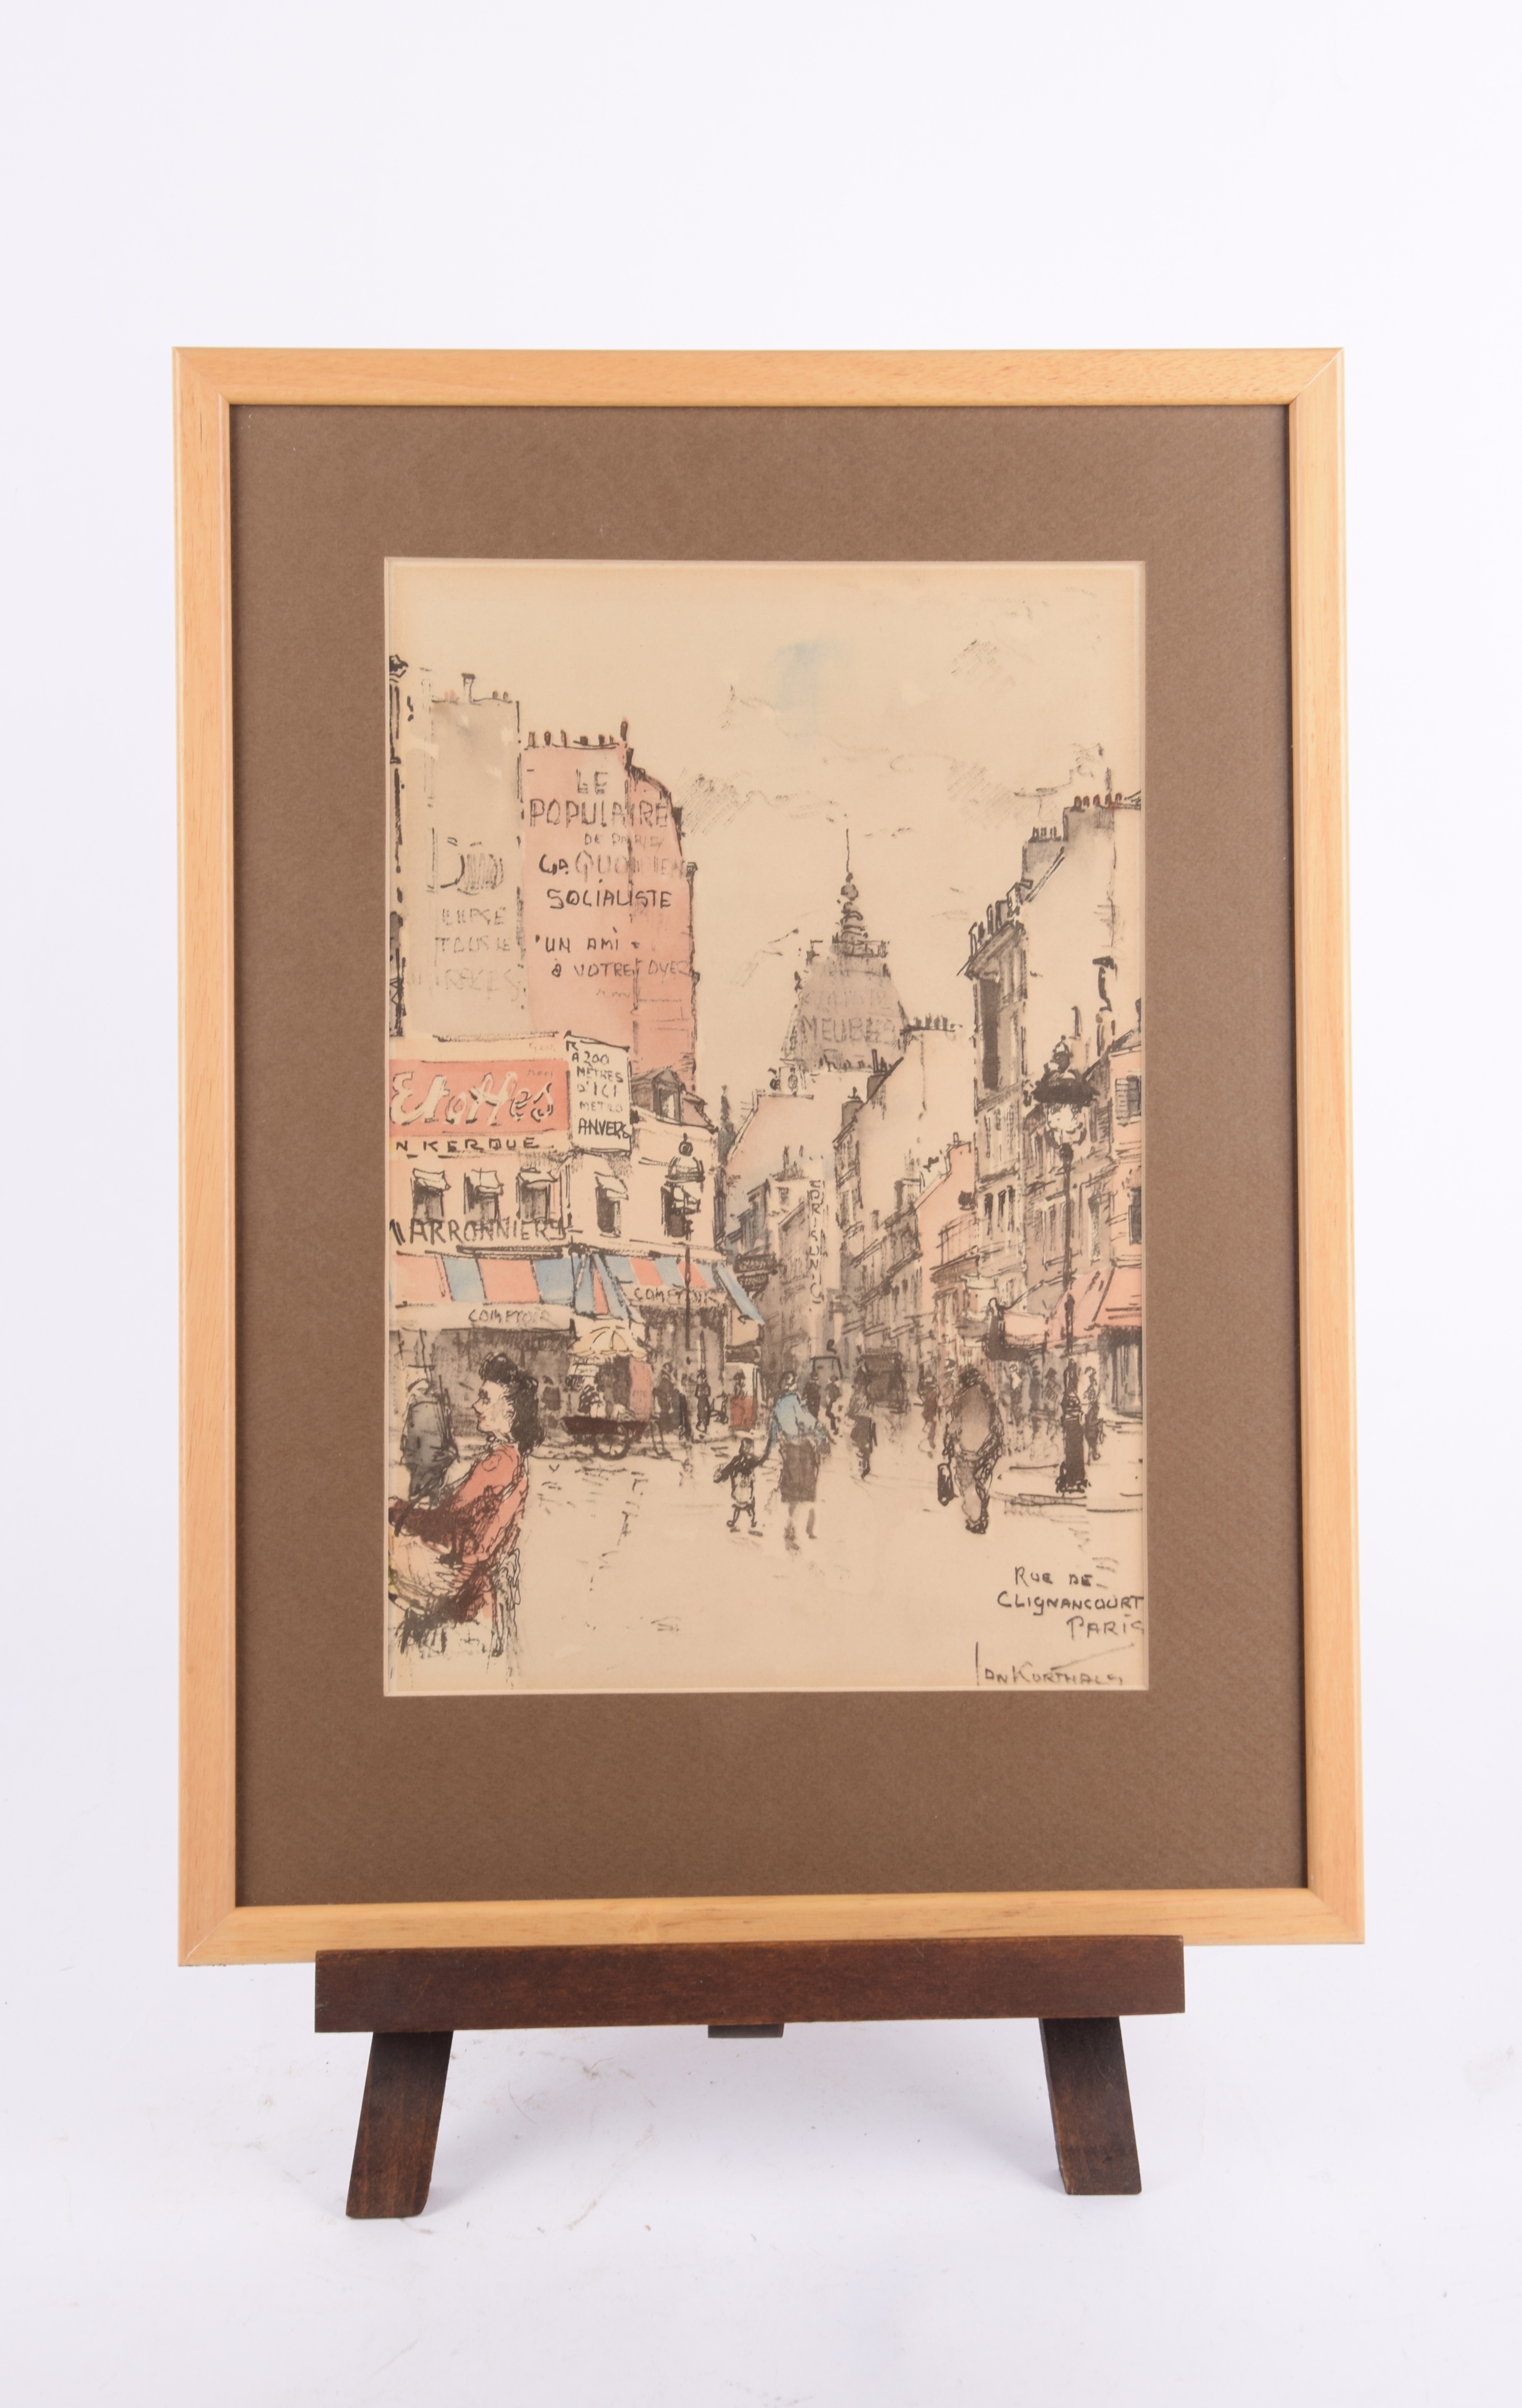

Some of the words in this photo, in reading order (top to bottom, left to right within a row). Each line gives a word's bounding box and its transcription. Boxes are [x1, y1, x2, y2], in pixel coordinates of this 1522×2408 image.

[576, 769, 608, 794] LE
[530, 798, 668, 828] POPULAIRE
[547, 888, 672, 909] SOCIALISTE
[574, 962, 633, 977] VOTRE
[584, 1051, 610, 1066] 200
